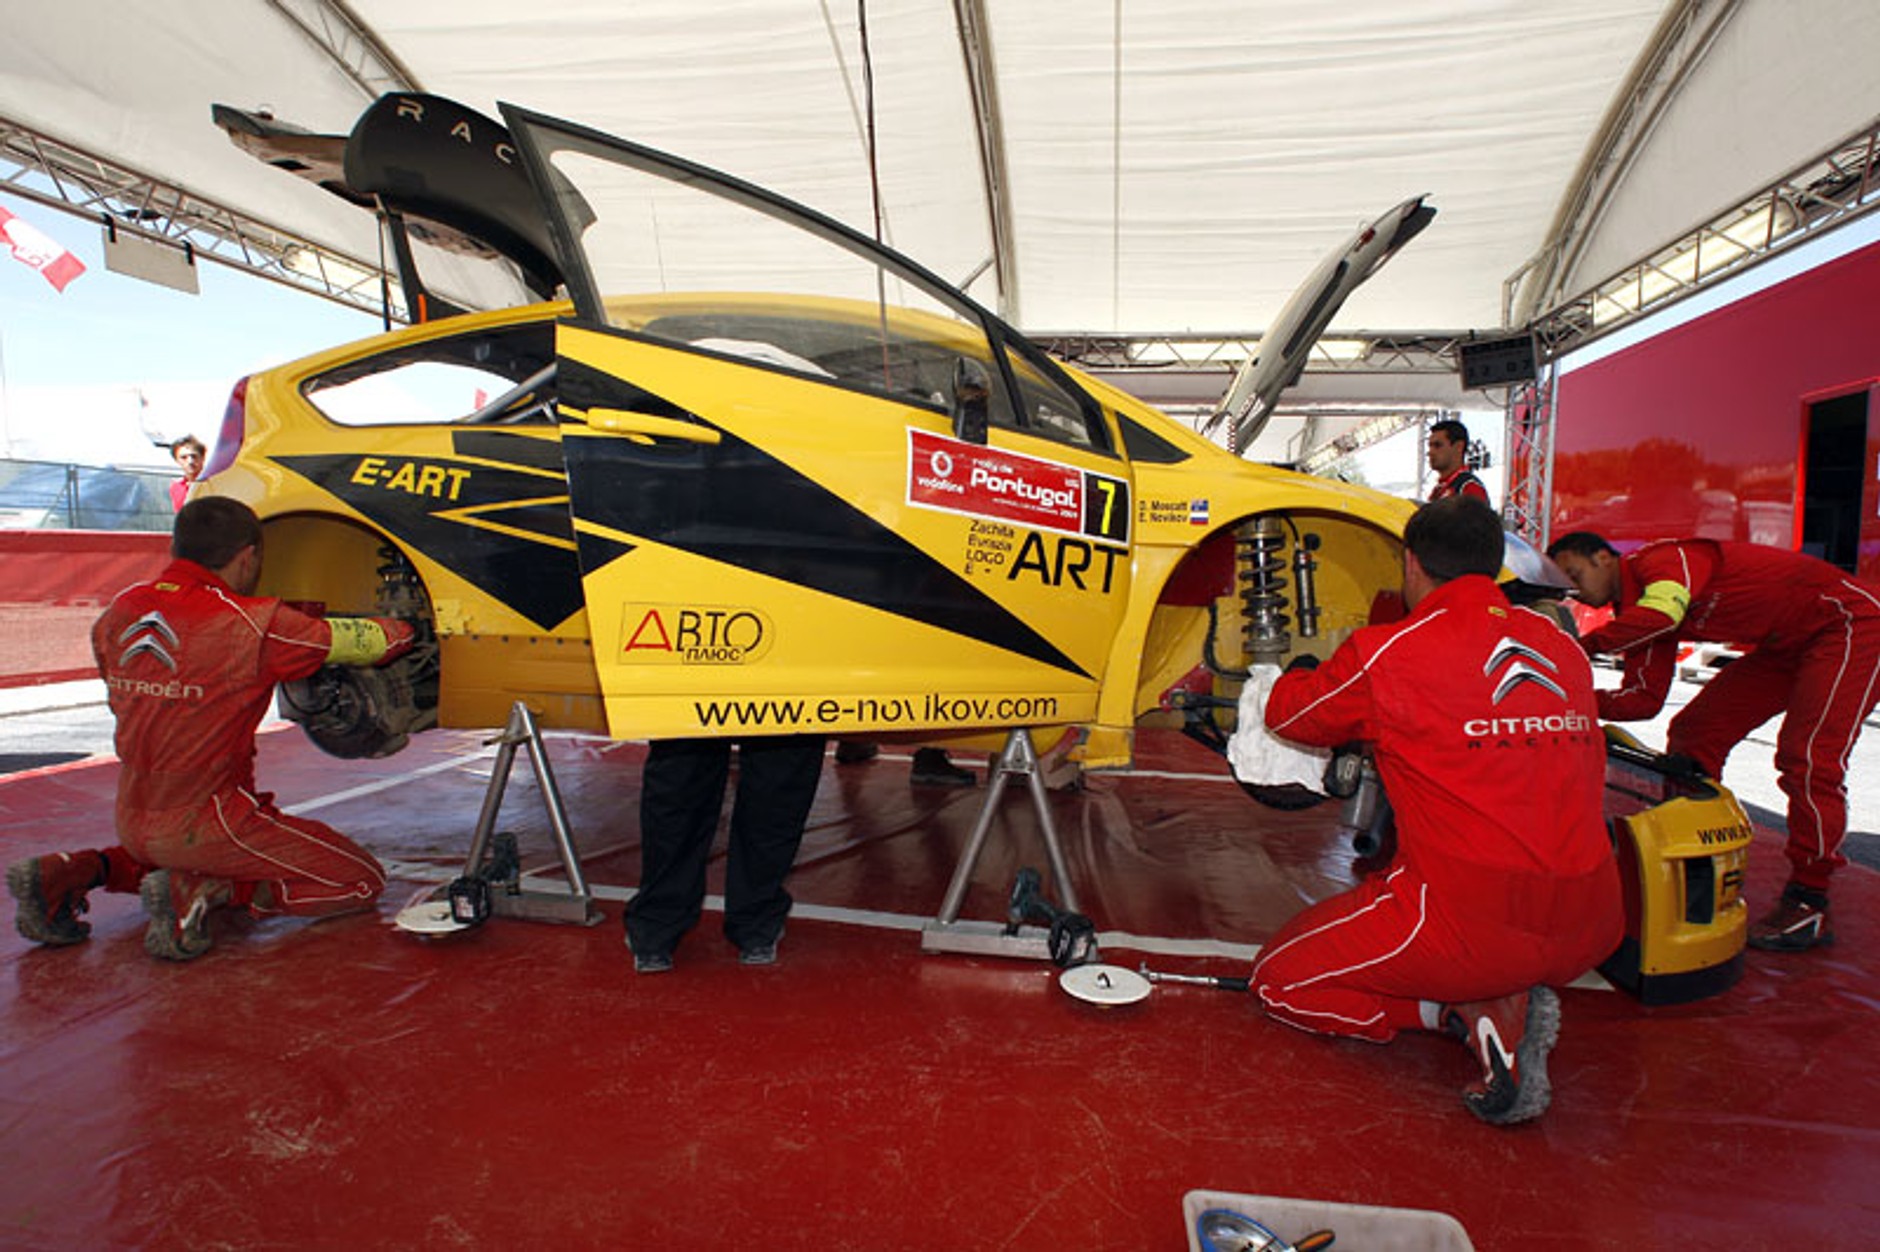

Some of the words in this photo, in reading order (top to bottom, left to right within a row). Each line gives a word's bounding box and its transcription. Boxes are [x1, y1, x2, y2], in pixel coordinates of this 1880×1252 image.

[351, 457, 472, 501] E-ART
[917, 476, 965, 495] vodafone
[970, 467, 1078, 509] Portugal
[1097, 480, 1116, 535] 7
[965, 548, 1005, 565] LOGO
[1007, 530, 1129, 594] ART
[686, 647, 742, 662] ПЛЮС
